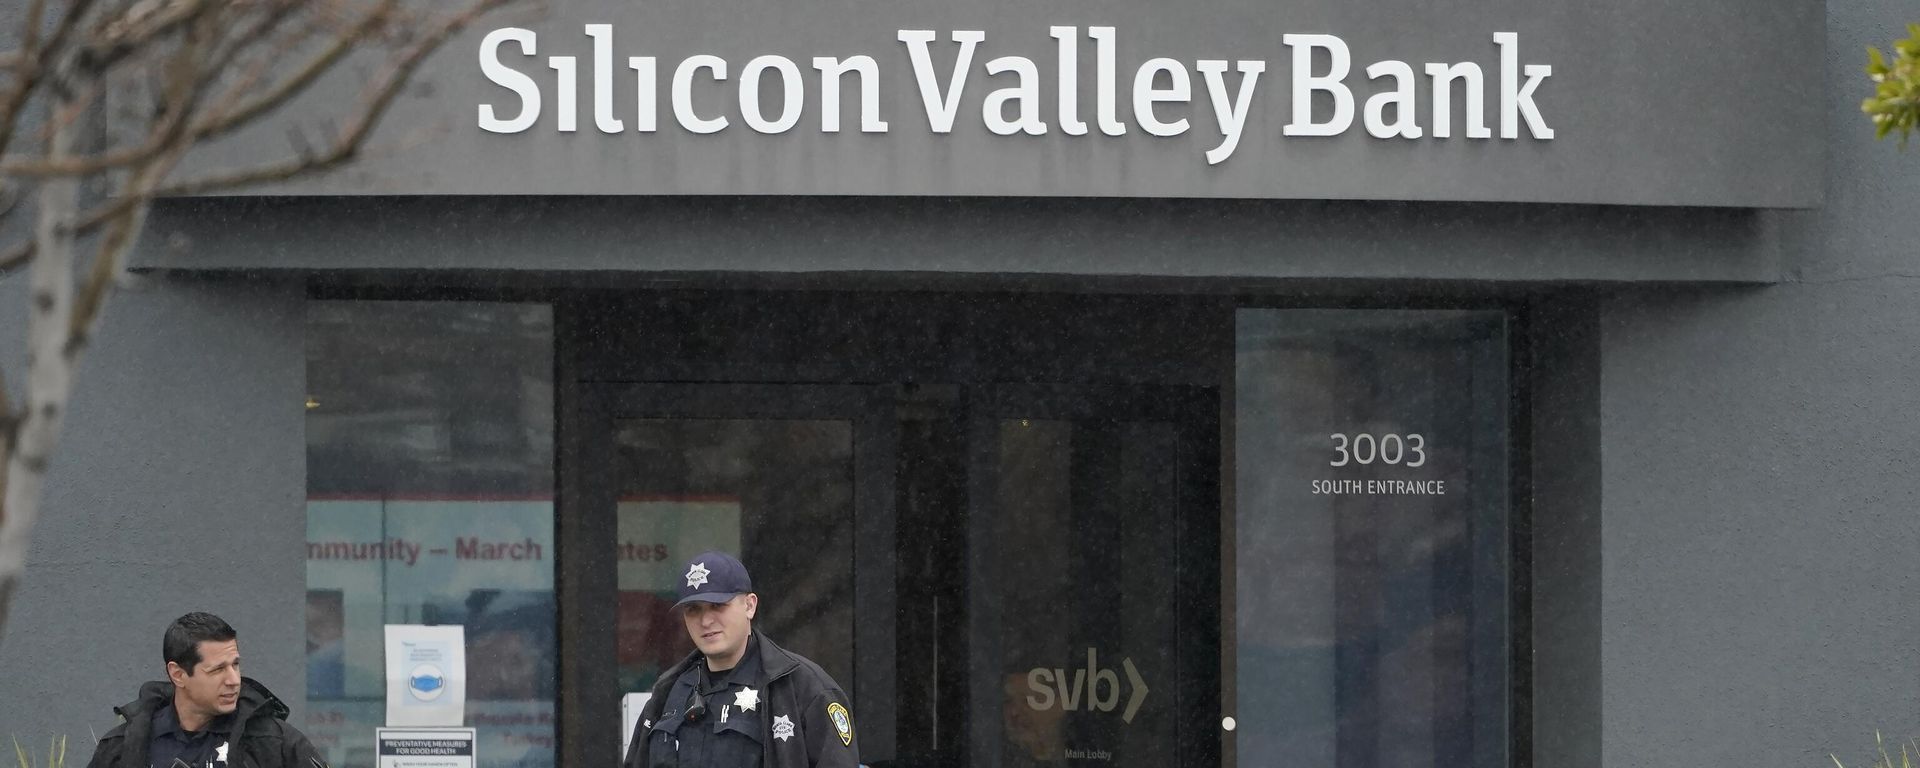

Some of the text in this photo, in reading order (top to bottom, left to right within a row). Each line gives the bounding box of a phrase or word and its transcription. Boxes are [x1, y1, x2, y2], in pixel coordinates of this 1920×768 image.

[898, 26, 1265, 165] Valley
[1283, 32, 1554, 140] Bank
[1330, 433, 1426, 467] 3003
[1312, 479, 1445, 495] SOUTH ENTRANCE
[455, 537, 542, 561] March
[1065, 749, 1112, 760] Main Lobby
